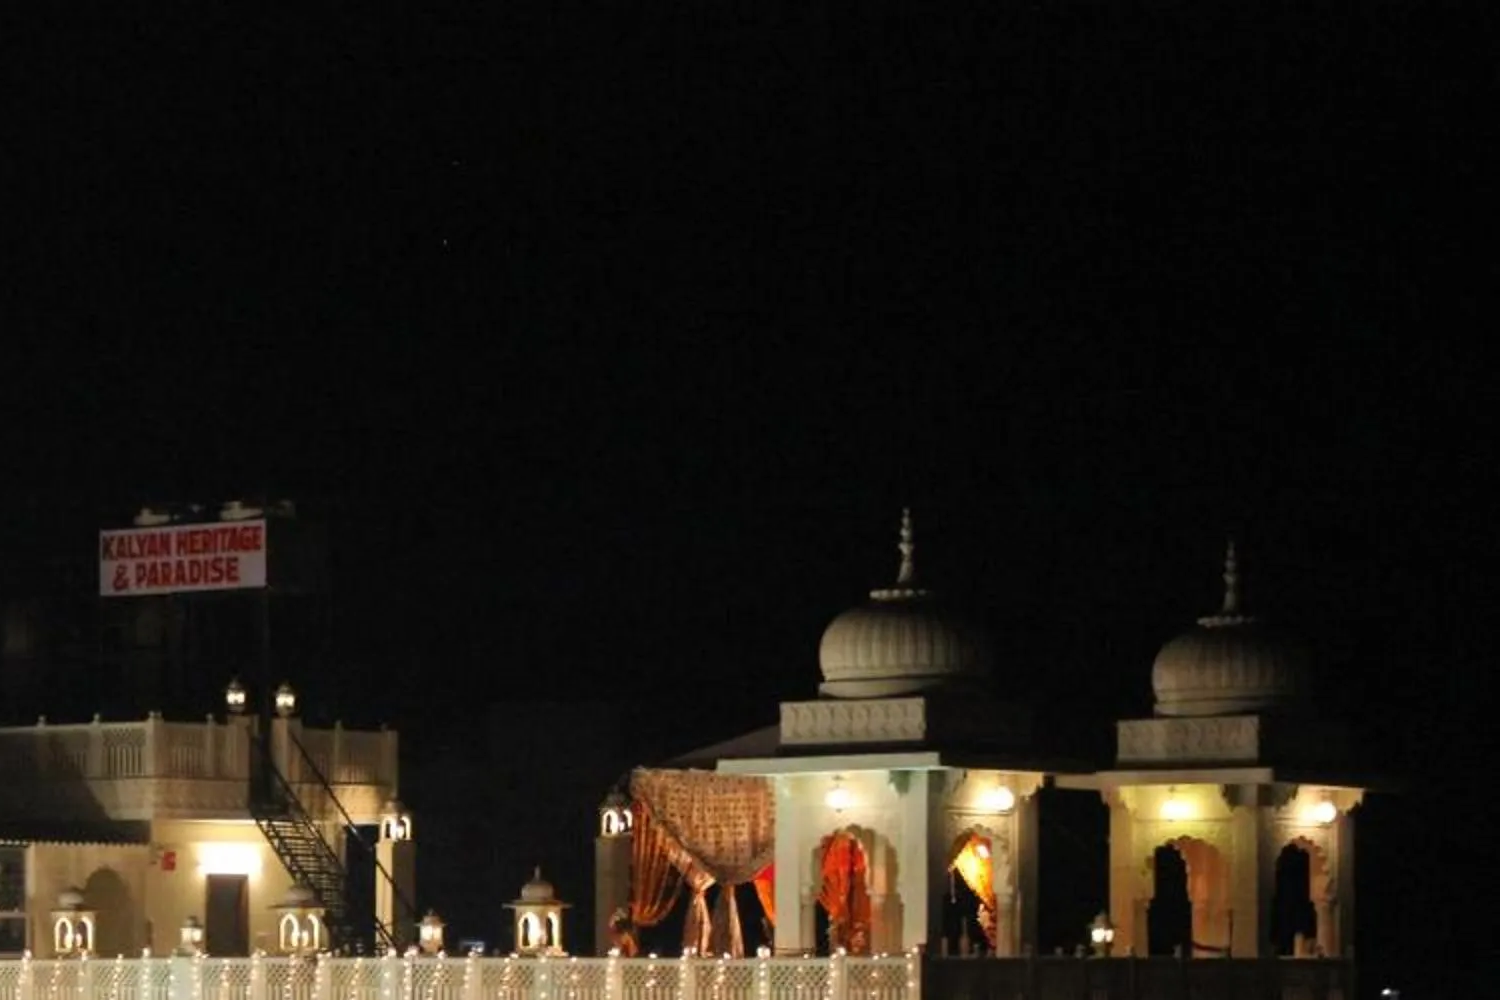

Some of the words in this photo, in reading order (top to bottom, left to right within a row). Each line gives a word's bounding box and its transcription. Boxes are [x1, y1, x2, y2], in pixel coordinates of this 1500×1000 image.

[102, 534, 171, 561] KALYAN
[176, 525, 262, 555] HERITAGE
[112, 566, 130, 591] &
[136, 557, 241, 587] PARADISE
